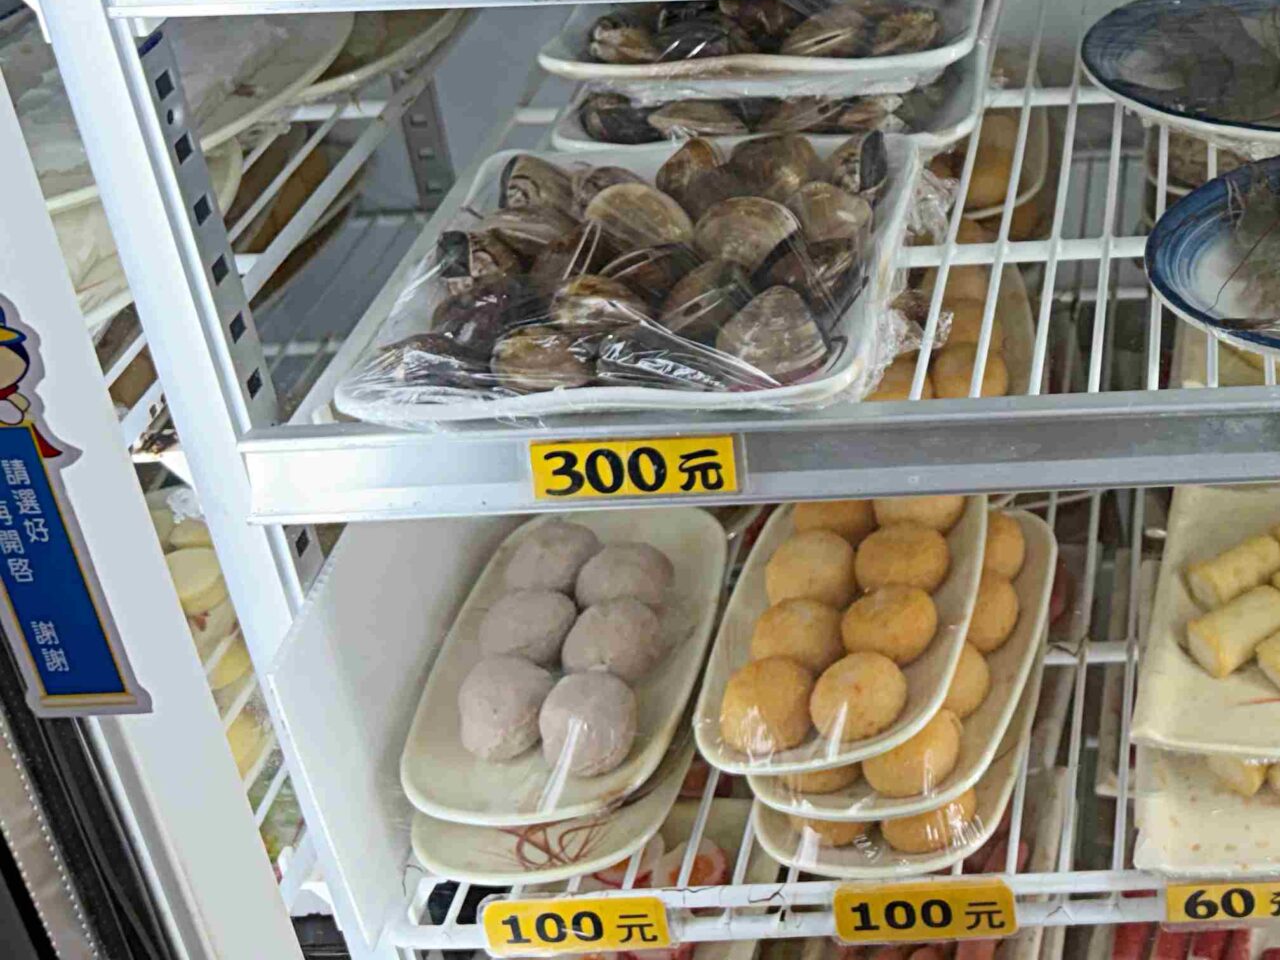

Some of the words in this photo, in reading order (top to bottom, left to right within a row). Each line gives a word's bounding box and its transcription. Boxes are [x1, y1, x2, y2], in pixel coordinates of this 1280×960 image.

[543, 447, 724, 495] 300元
[1, 459, 49, 543] 請選好
[31, 621, 70, 672] 謝謝
[502, 911, 658, 944] 100元
[851, 899, 1006, 932] 100元
